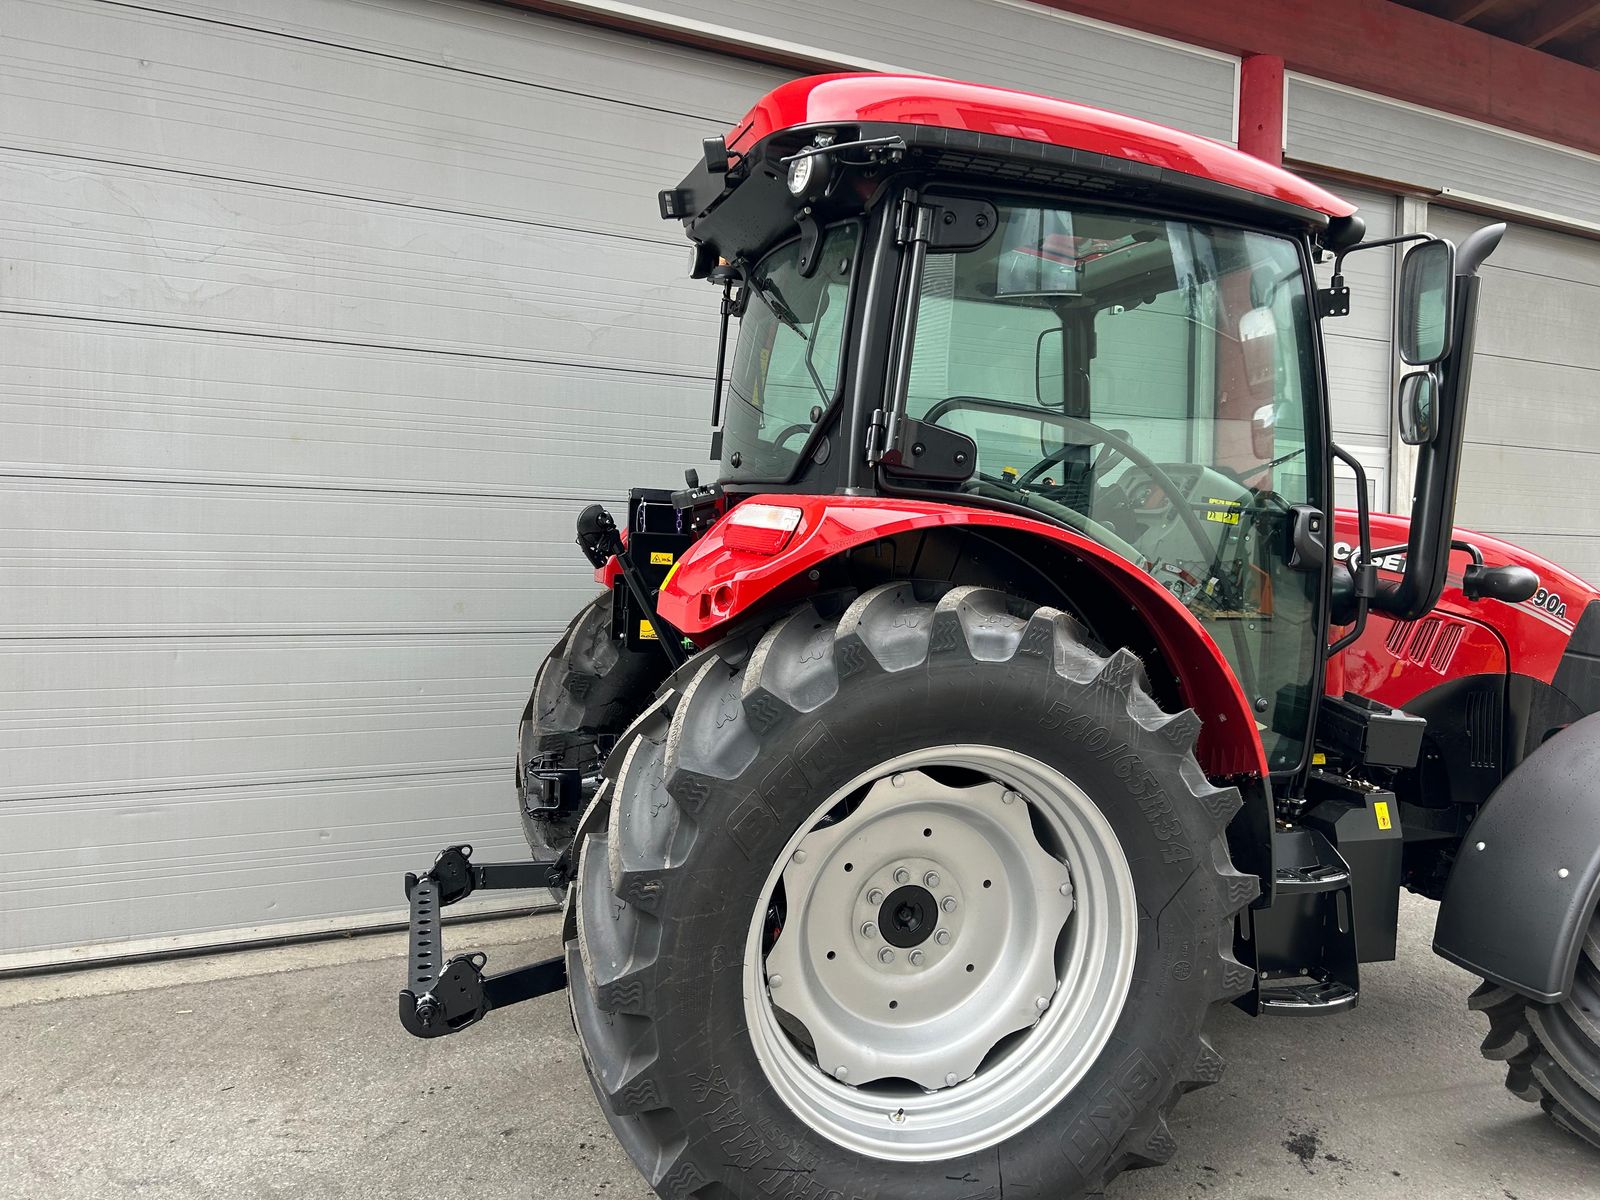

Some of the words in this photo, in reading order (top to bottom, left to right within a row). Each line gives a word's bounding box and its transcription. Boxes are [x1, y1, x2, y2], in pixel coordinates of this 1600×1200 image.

[1533, 587, 1567, 619] 90A
[1038, 701, 1192, 865] 540/65R34
[688, 1064, 860, 1200] RIMAX
